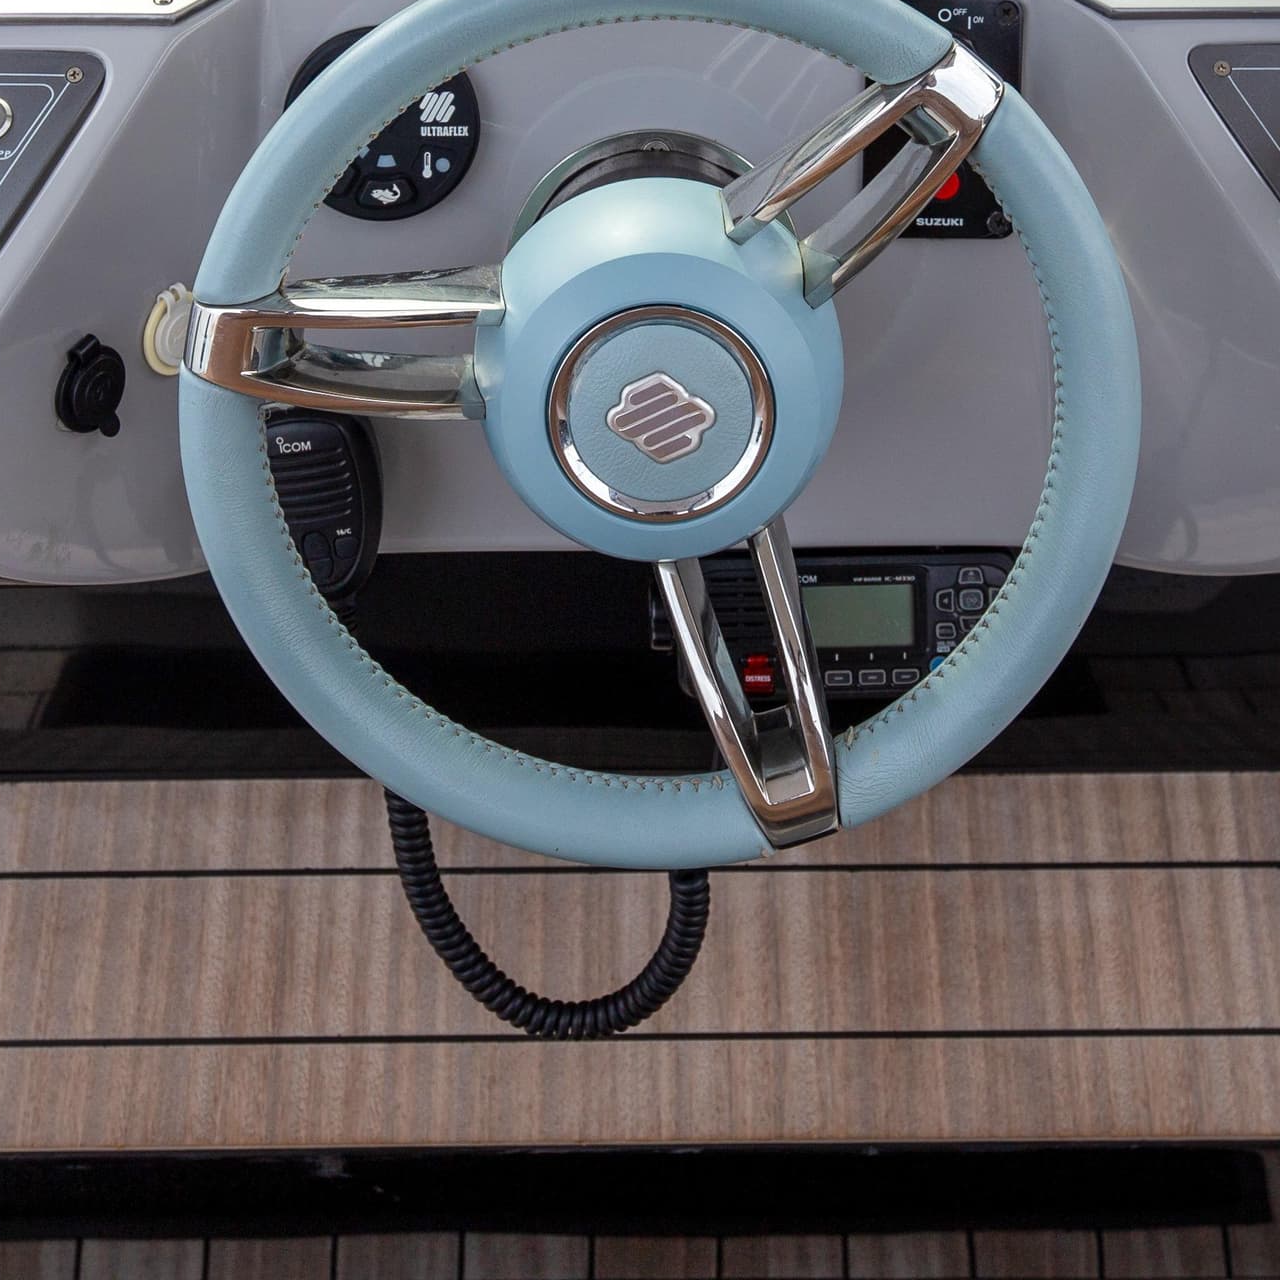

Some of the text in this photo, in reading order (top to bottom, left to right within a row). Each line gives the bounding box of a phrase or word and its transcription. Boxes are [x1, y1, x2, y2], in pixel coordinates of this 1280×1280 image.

[952, 7, 968, 16] OFF
[972, 15, 985, 24] ON
[420, 126, 469, 136] ULTRAFLEX
[916, 218, 964, 227] SUZUKI
